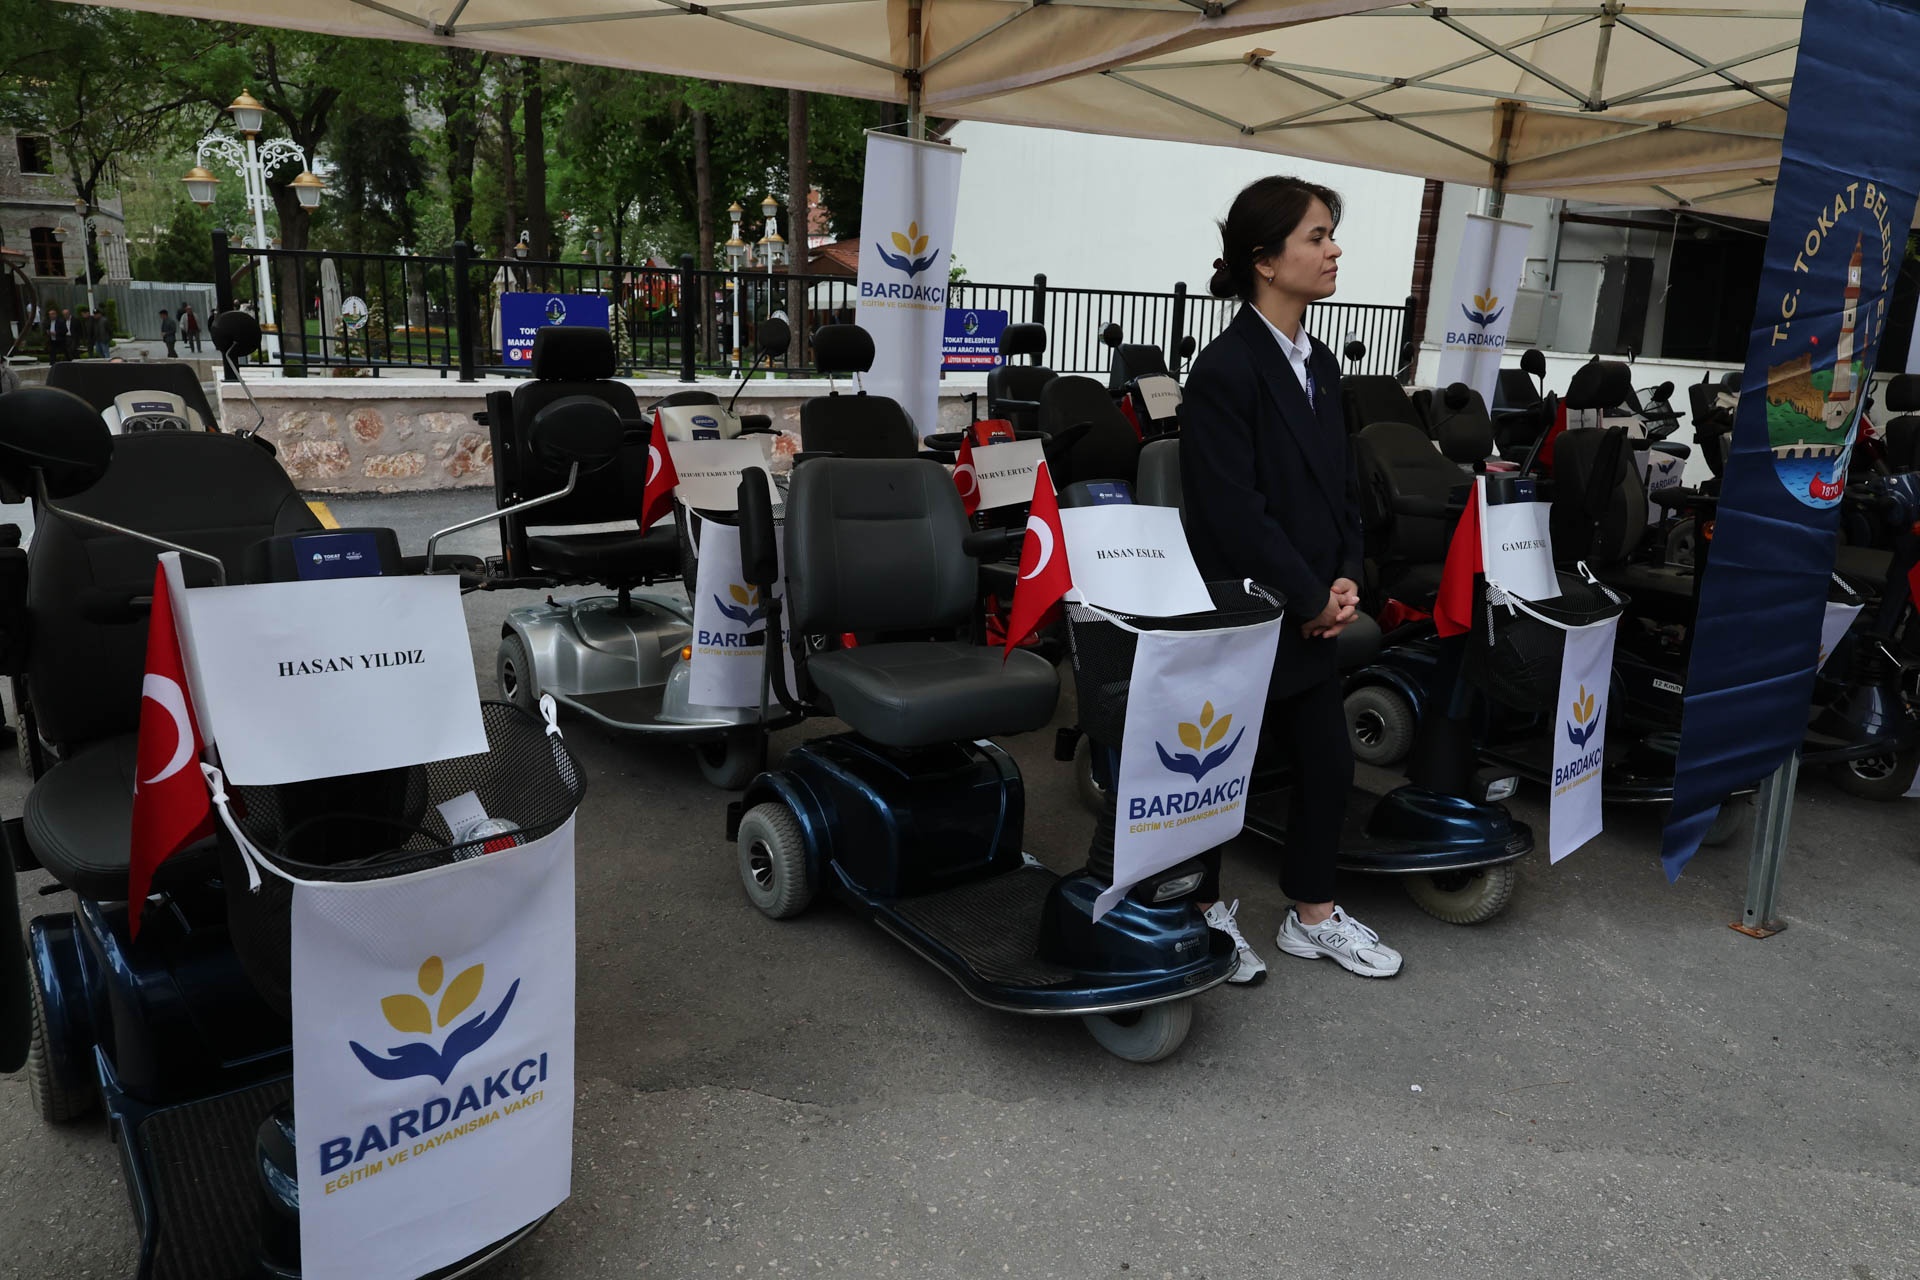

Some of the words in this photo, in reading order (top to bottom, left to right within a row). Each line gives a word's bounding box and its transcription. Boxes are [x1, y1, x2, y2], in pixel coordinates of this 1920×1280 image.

[1793, 182, 1859, 274] TOKAT
[861, 282, 945, 304] BARDAKÇI
[519, 327, 538, 335] TOK
[1446, 332, 1505, 348] BARDAKÇI
[978, 470, 1005, 480] MERVE
[1007, 466, 1033, 475] ERTEN
[1822, 485, 1839, 497] 1870
[1097, 549, 1134, 559] HASAN
[1136, 549, 1165, 559] ESLEK
[1502, 541, 1532, 551] GAMZE
[278, 656, 354, 677] HASAN
[359, 649, 425, 669] YILDIZ
[1555, 745, 1602, 787] BARDAKÇI
[1129, 775, 1246, 820] BARDAKÇI
[1163, 820, 1175, 829] VE
[319, 1052, 548, 1176] BARDAKÇI
[325, 1160, 383, 1195] EĞİTİM
[387, 1149, 409, 1167] VE
[503, 1089, 545, 1116] VAKFI
